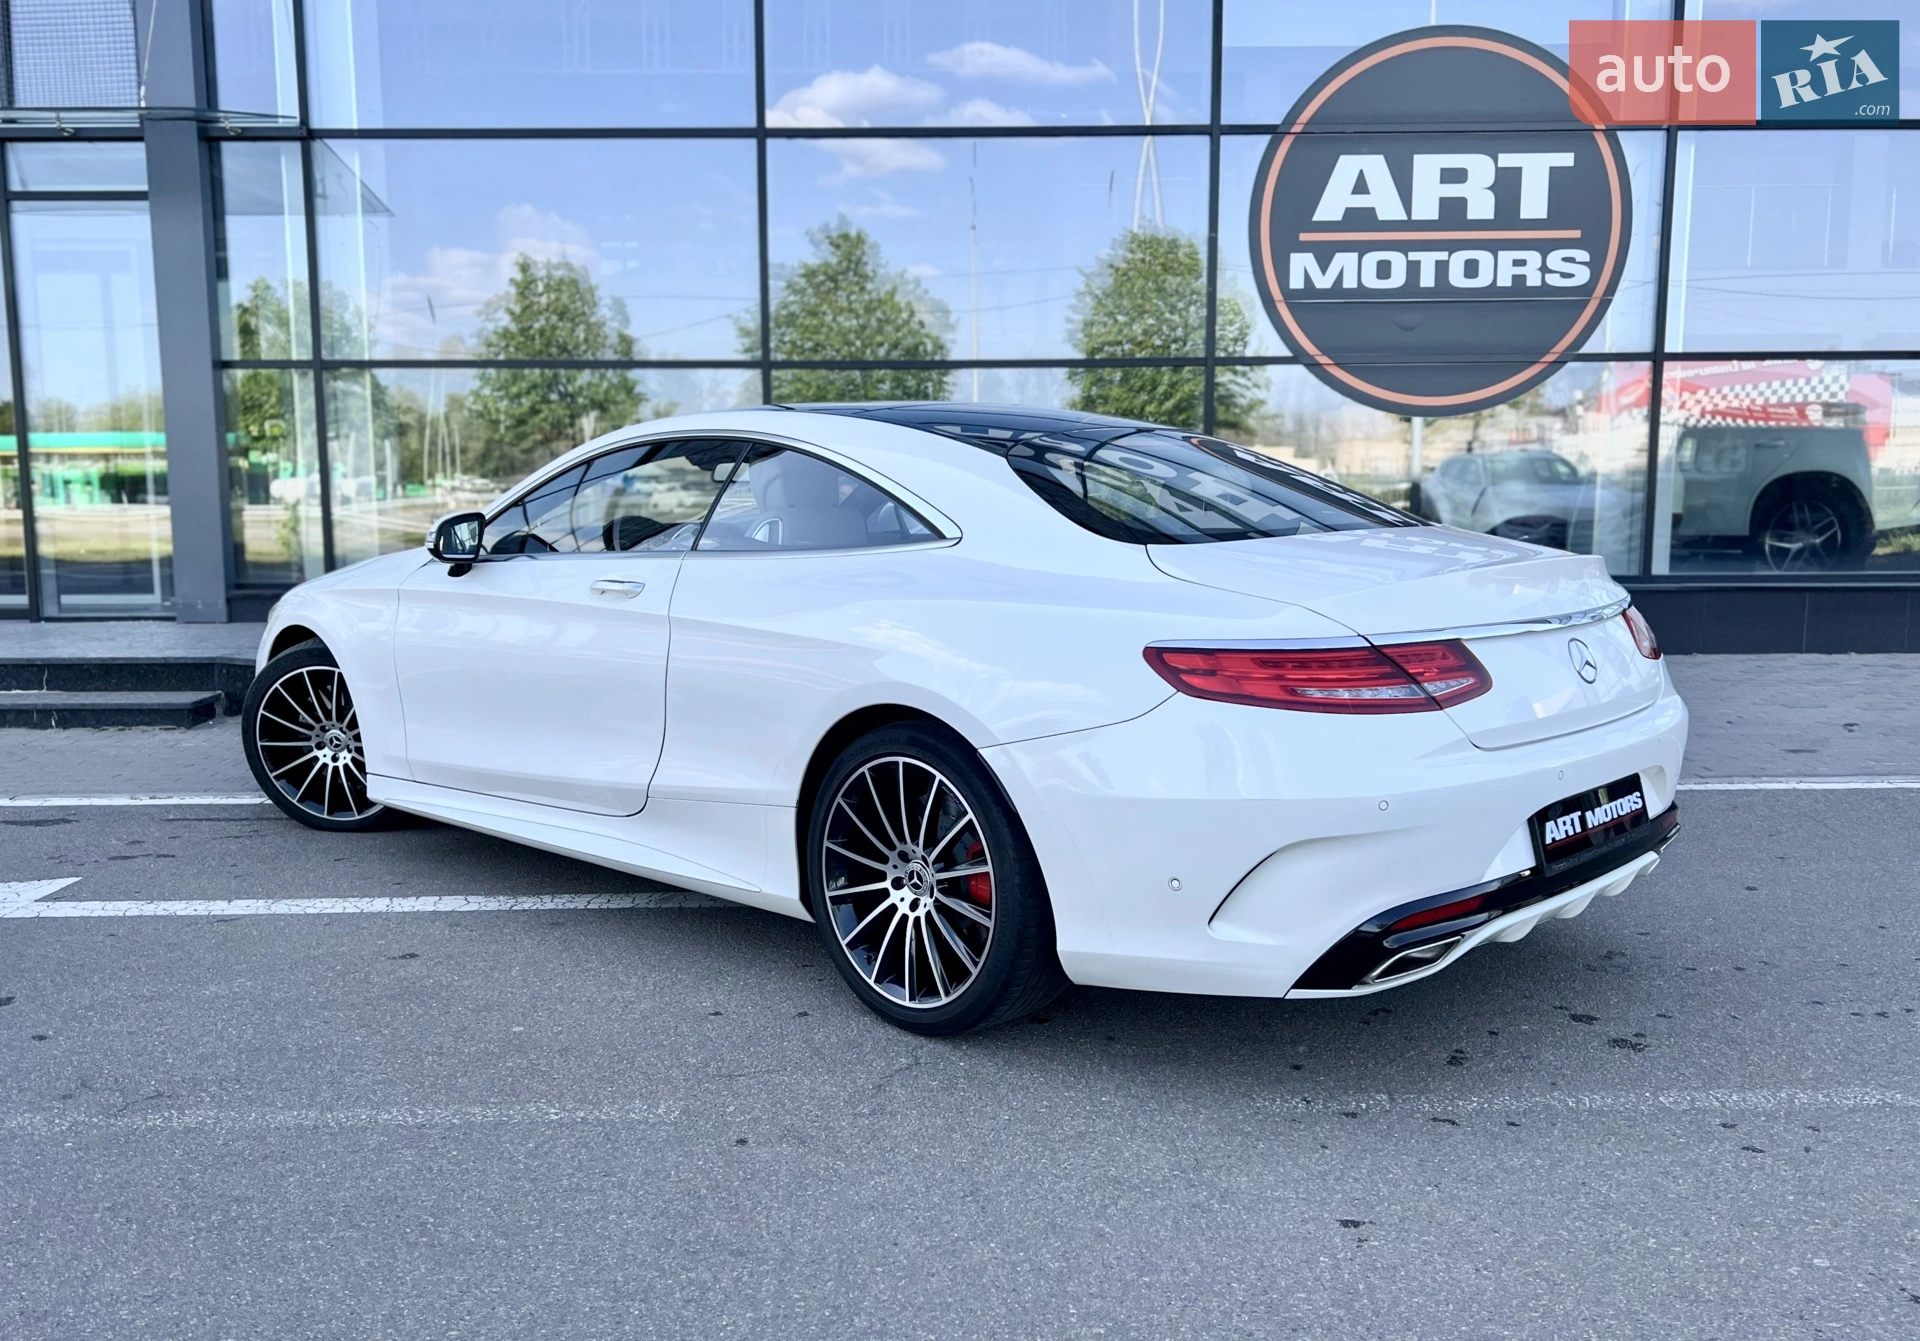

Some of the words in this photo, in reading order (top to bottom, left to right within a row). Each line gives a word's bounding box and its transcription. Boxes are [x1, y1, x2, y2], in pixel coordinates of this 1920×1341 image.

[1312, 152, 1575, 221] ART
[1289, 249, 1591, 290] MOTORS
[1545, 812, 1582, 845] ART
[1587, 792, 1643, 828] MOTORS
